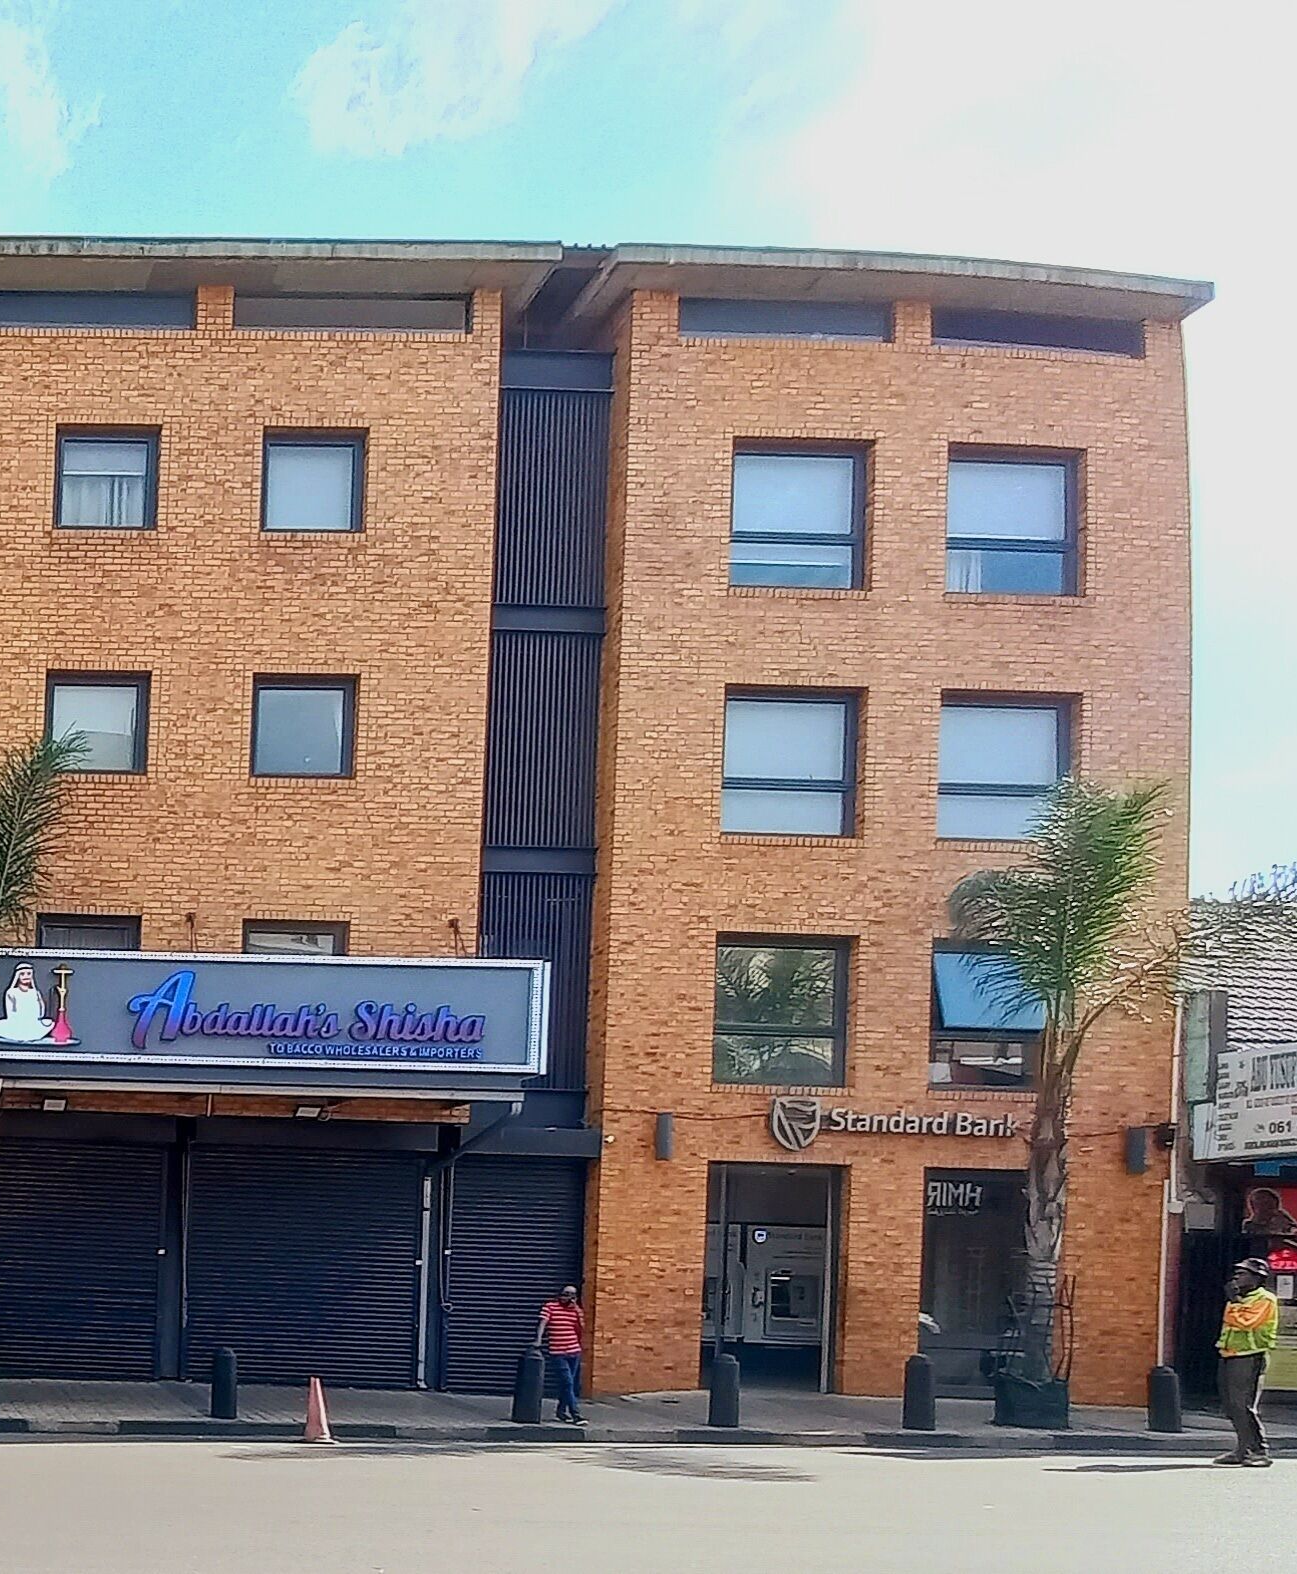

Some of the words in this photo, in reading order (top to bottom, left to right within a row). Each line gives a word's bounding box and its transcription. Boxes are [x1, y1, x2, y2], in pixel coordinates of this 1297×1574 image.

[129, 970, 341, 1049] Abdallah's
[350, 1000, 485, 1043] Shisha
[324, 1044, 406, 1057] WHOLESALERS
[409, 1047, 417, 1057] &
[419, 1046, 482, 1059] IMPORTERS
[829, 1107, 949, 1136] Standard
[955, 1112, 1020, 1137] Bank
[1269, 1121, 1292, 1134] 061
